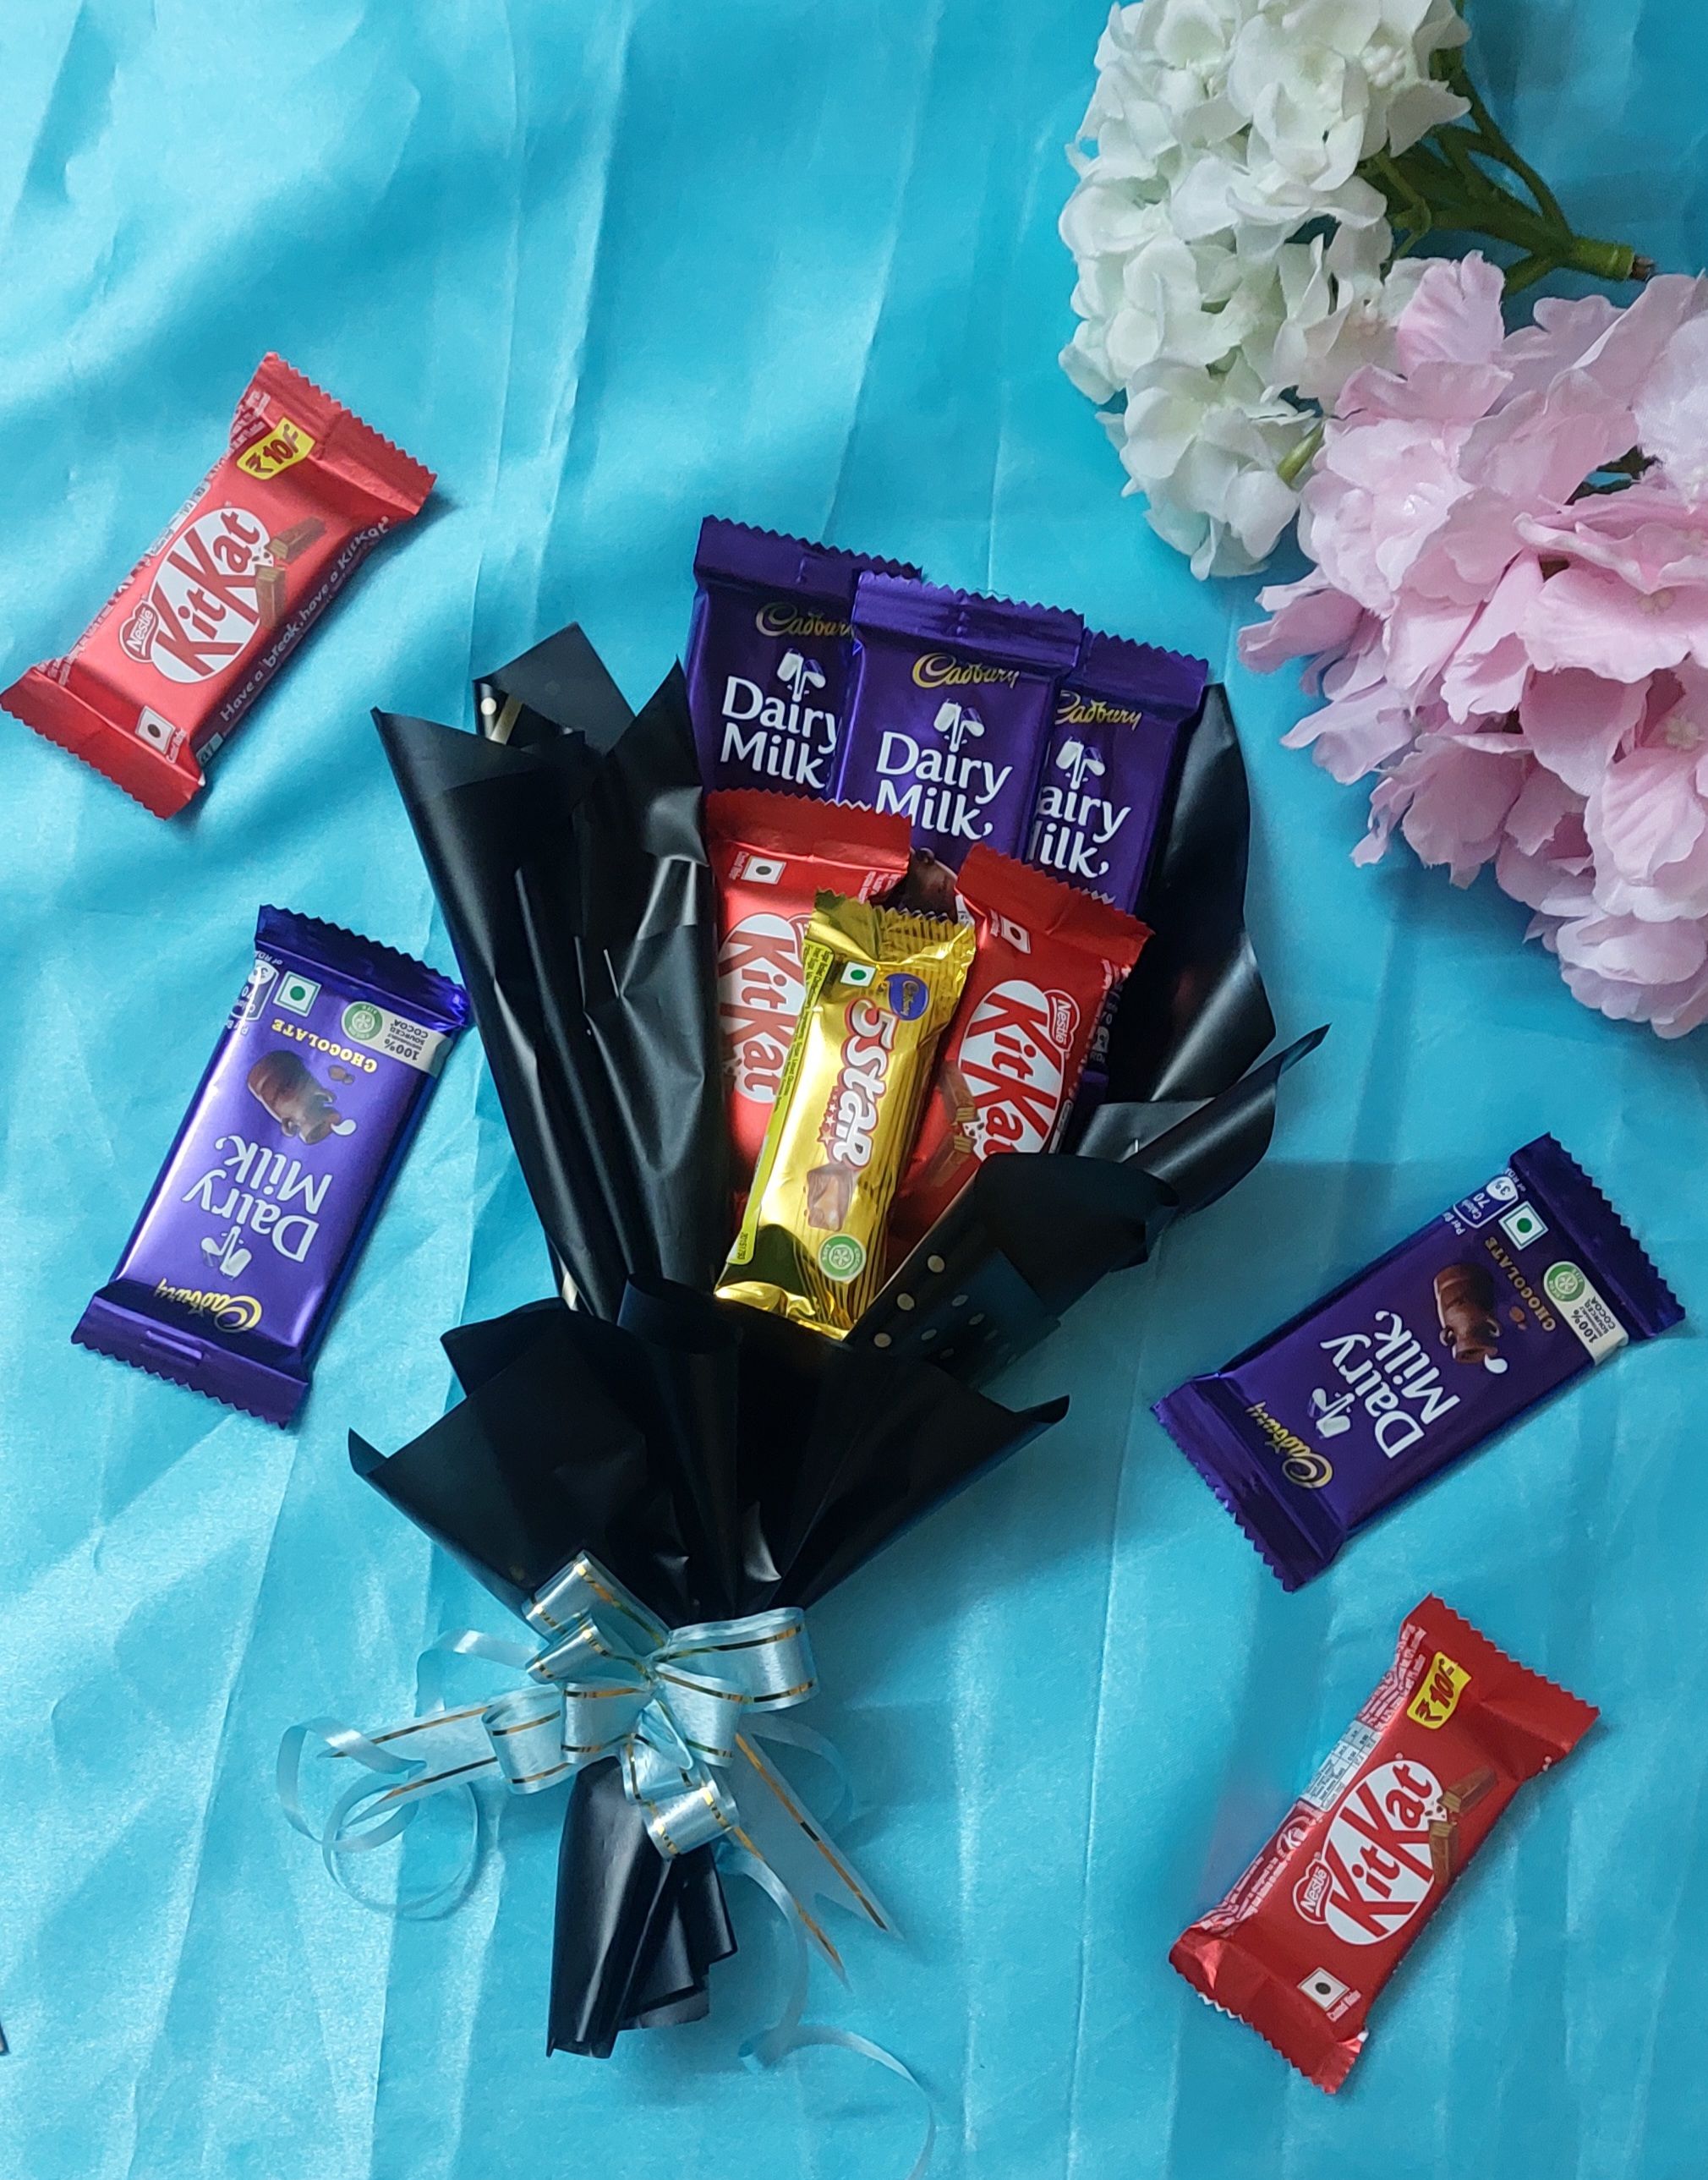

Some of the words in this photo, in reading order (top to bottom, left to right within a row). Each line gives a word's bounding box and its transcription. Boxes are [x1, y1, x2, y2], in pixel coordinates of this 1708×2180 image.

[151, 511, 260, 676] KitKat
[220, 683, 253, 721] Have
[298, 584, 331, 622] have
[911, 652, 1020, 688] Cadbury
[721, 676, 837, 755] Dairy
[876, 731, 1013, 805] Dairy
[1037, 786, 1132, 844] airy
[271, 1018, 378, 1073] CHOCOLATE
[384, 1038, 420, 1061] 100%
[181, 1169, 320, 1263] Dairy
[1473, 1192, 1491, 1209] 70
[154, 1278, 263, 1334] Cadbury
[1484, 1235, 1557, 1332] CHOCOLATE
[1570, 1308, 1599, 1345] 100%
[1320, 1334, 1426, 1460] Dairy
[1245, 1401, 1333, 1489] Cadbury
[1324, 1763, 1434, 1938] KitKat
